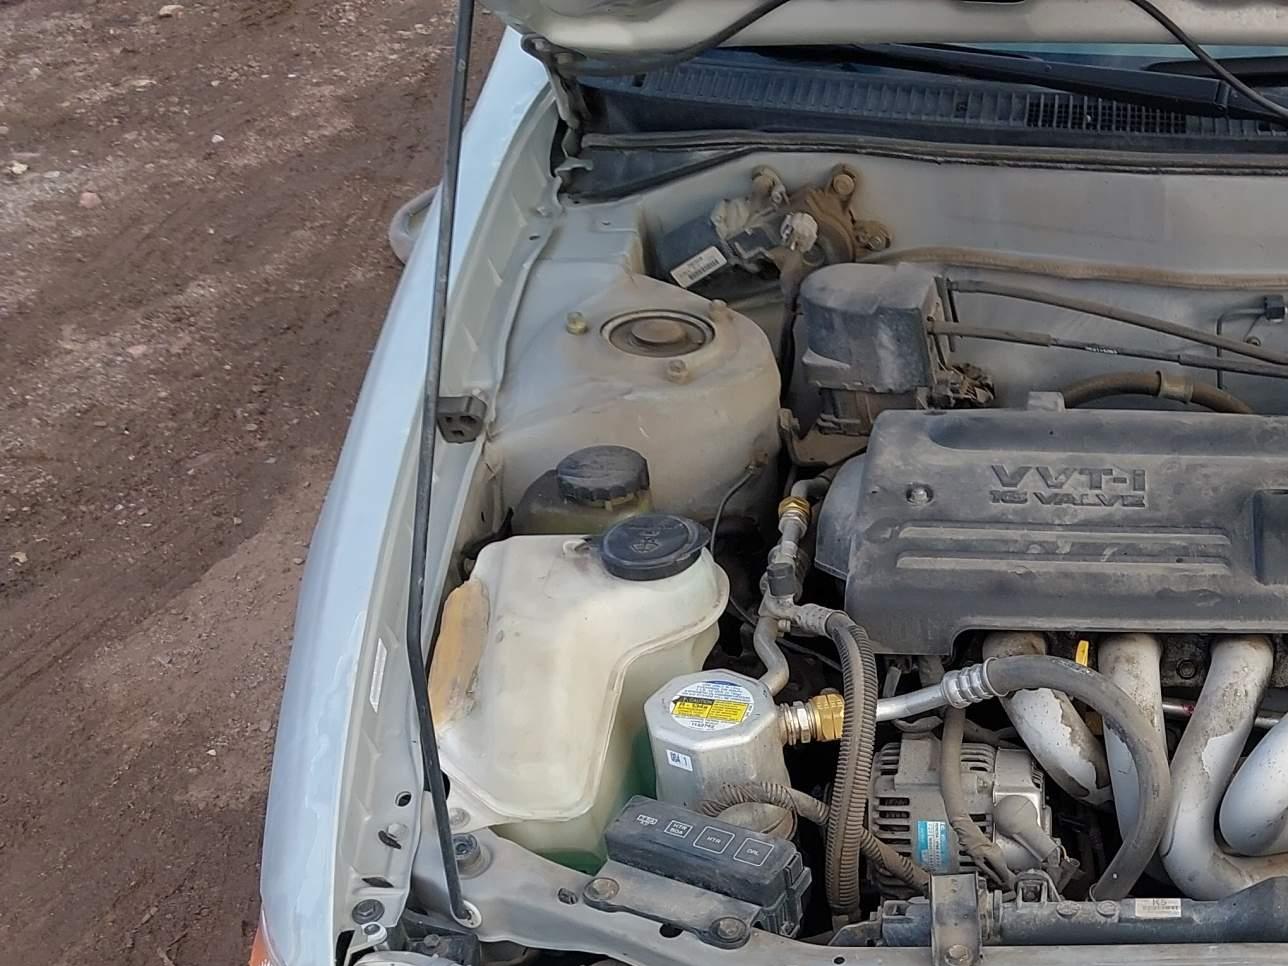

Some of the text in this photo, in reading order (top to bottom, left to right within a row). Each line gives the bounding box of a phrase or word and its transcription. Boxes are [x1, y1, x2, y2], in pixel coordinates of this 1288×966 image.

[989, 490, 1146, 508] 16 VALVE
[706, 835, 722, 844] HTR
